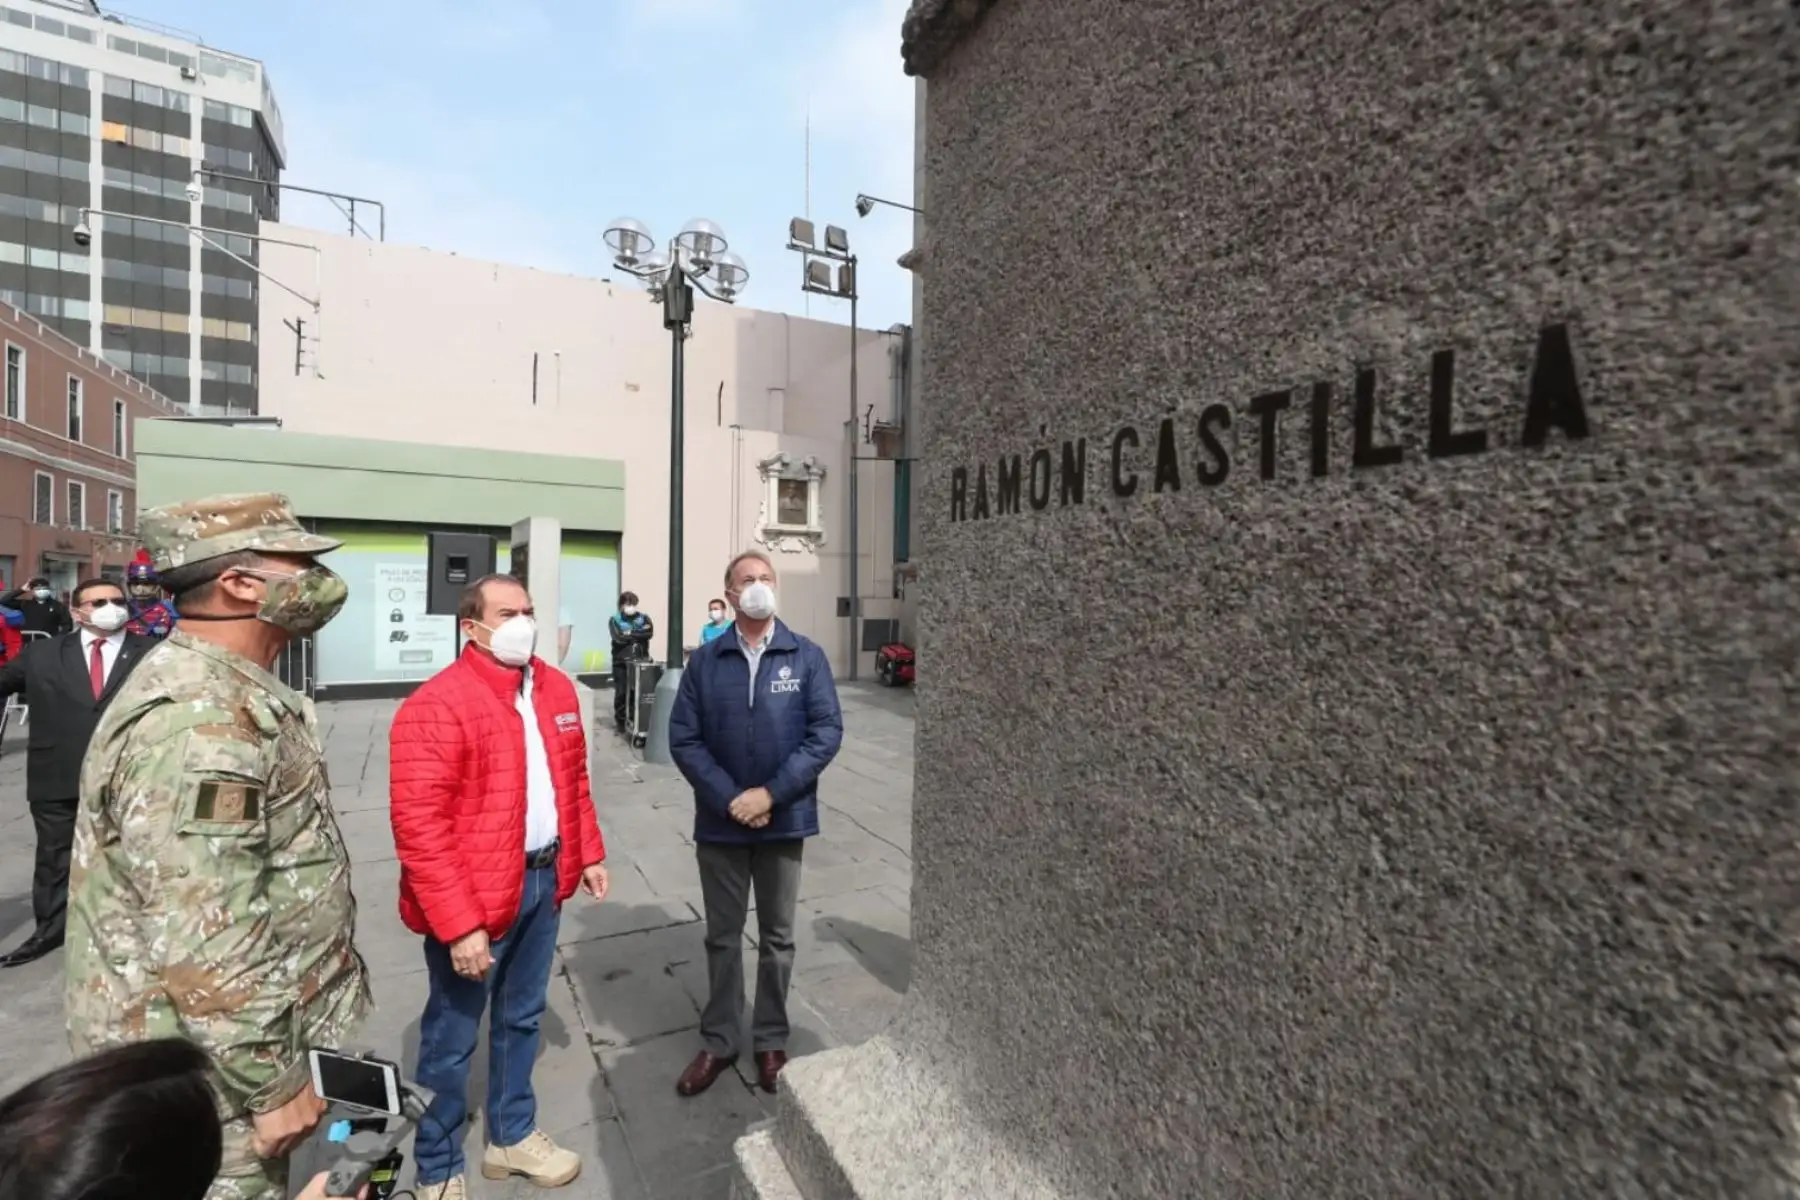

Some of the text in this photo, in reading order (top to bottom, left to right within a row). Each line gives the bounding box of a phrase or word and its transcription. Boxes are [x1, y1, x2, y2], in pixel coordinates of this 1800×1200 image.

[951, 323, 1589, 522] RAMÓN CASTILLA
[771, 683, 800, 692] LIMA
